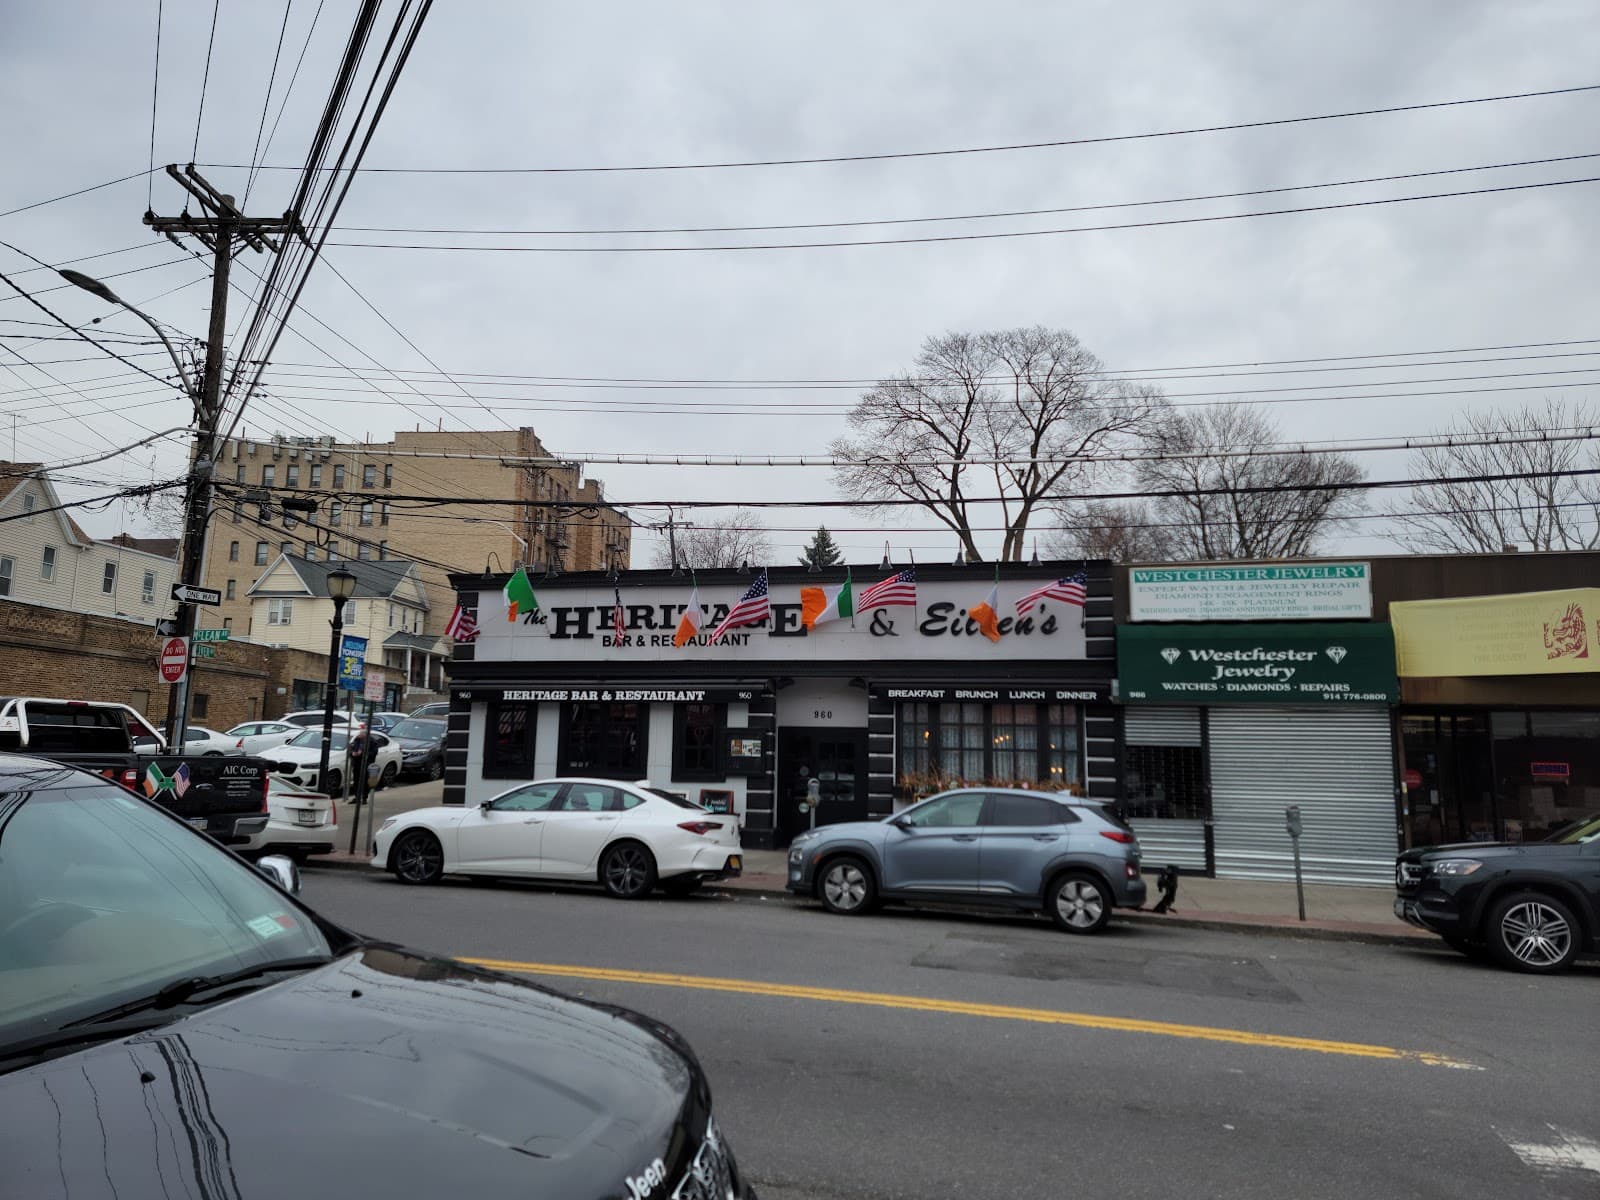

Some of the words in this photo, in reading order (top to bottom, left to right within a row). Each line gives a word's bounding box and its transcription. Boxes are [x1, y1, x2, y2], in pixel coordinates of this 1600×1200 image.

[1136, 569, 1268, 581] WESTCHESTER
[1273, 567, 1362, 579] JEWELRY
[186, 591, 200, 599] ONE
[1216, 591, 1301, 599] ENGAGEMENT
[521, 609, 548, 625] The
[869, 608, 899, 637] &
[636, 635, 646, 647] &
[165, 647, 174, 655] DO
[175, 646, 185, 654] NOT
[1188, 647, 1318, 661] Westchester
[165, 666, 181, 674] ENTER
[1211, 663, 1296, 682] Jewelry
[1161, 682, 1218, 691] WATCHES
[1226, 683, 1291, 691] DIAMONDS
[1300, 683, 1351, 692] REPAIRS
[459, 691, 471, 699] 960
[503, 690, 568, 700] HERITAGE
[571, 690, 599, 700] BAR
[601, 690, 612, 700] &
[615, 690, 705, 700] RESTAURANT
[738, 691, 752, 699] 960
[888, 689, 945, 698] BREAKFAST
[955, 690, 998, 699] BRUNCH
[1009, 690, 1045, 699] LUNCH
[1056, 691, 1097, 700] DINNER
[814, 711, 832, 719] 960
[223, 765, 239, 775] AIC
[240, 765, 258, 776] Corp
